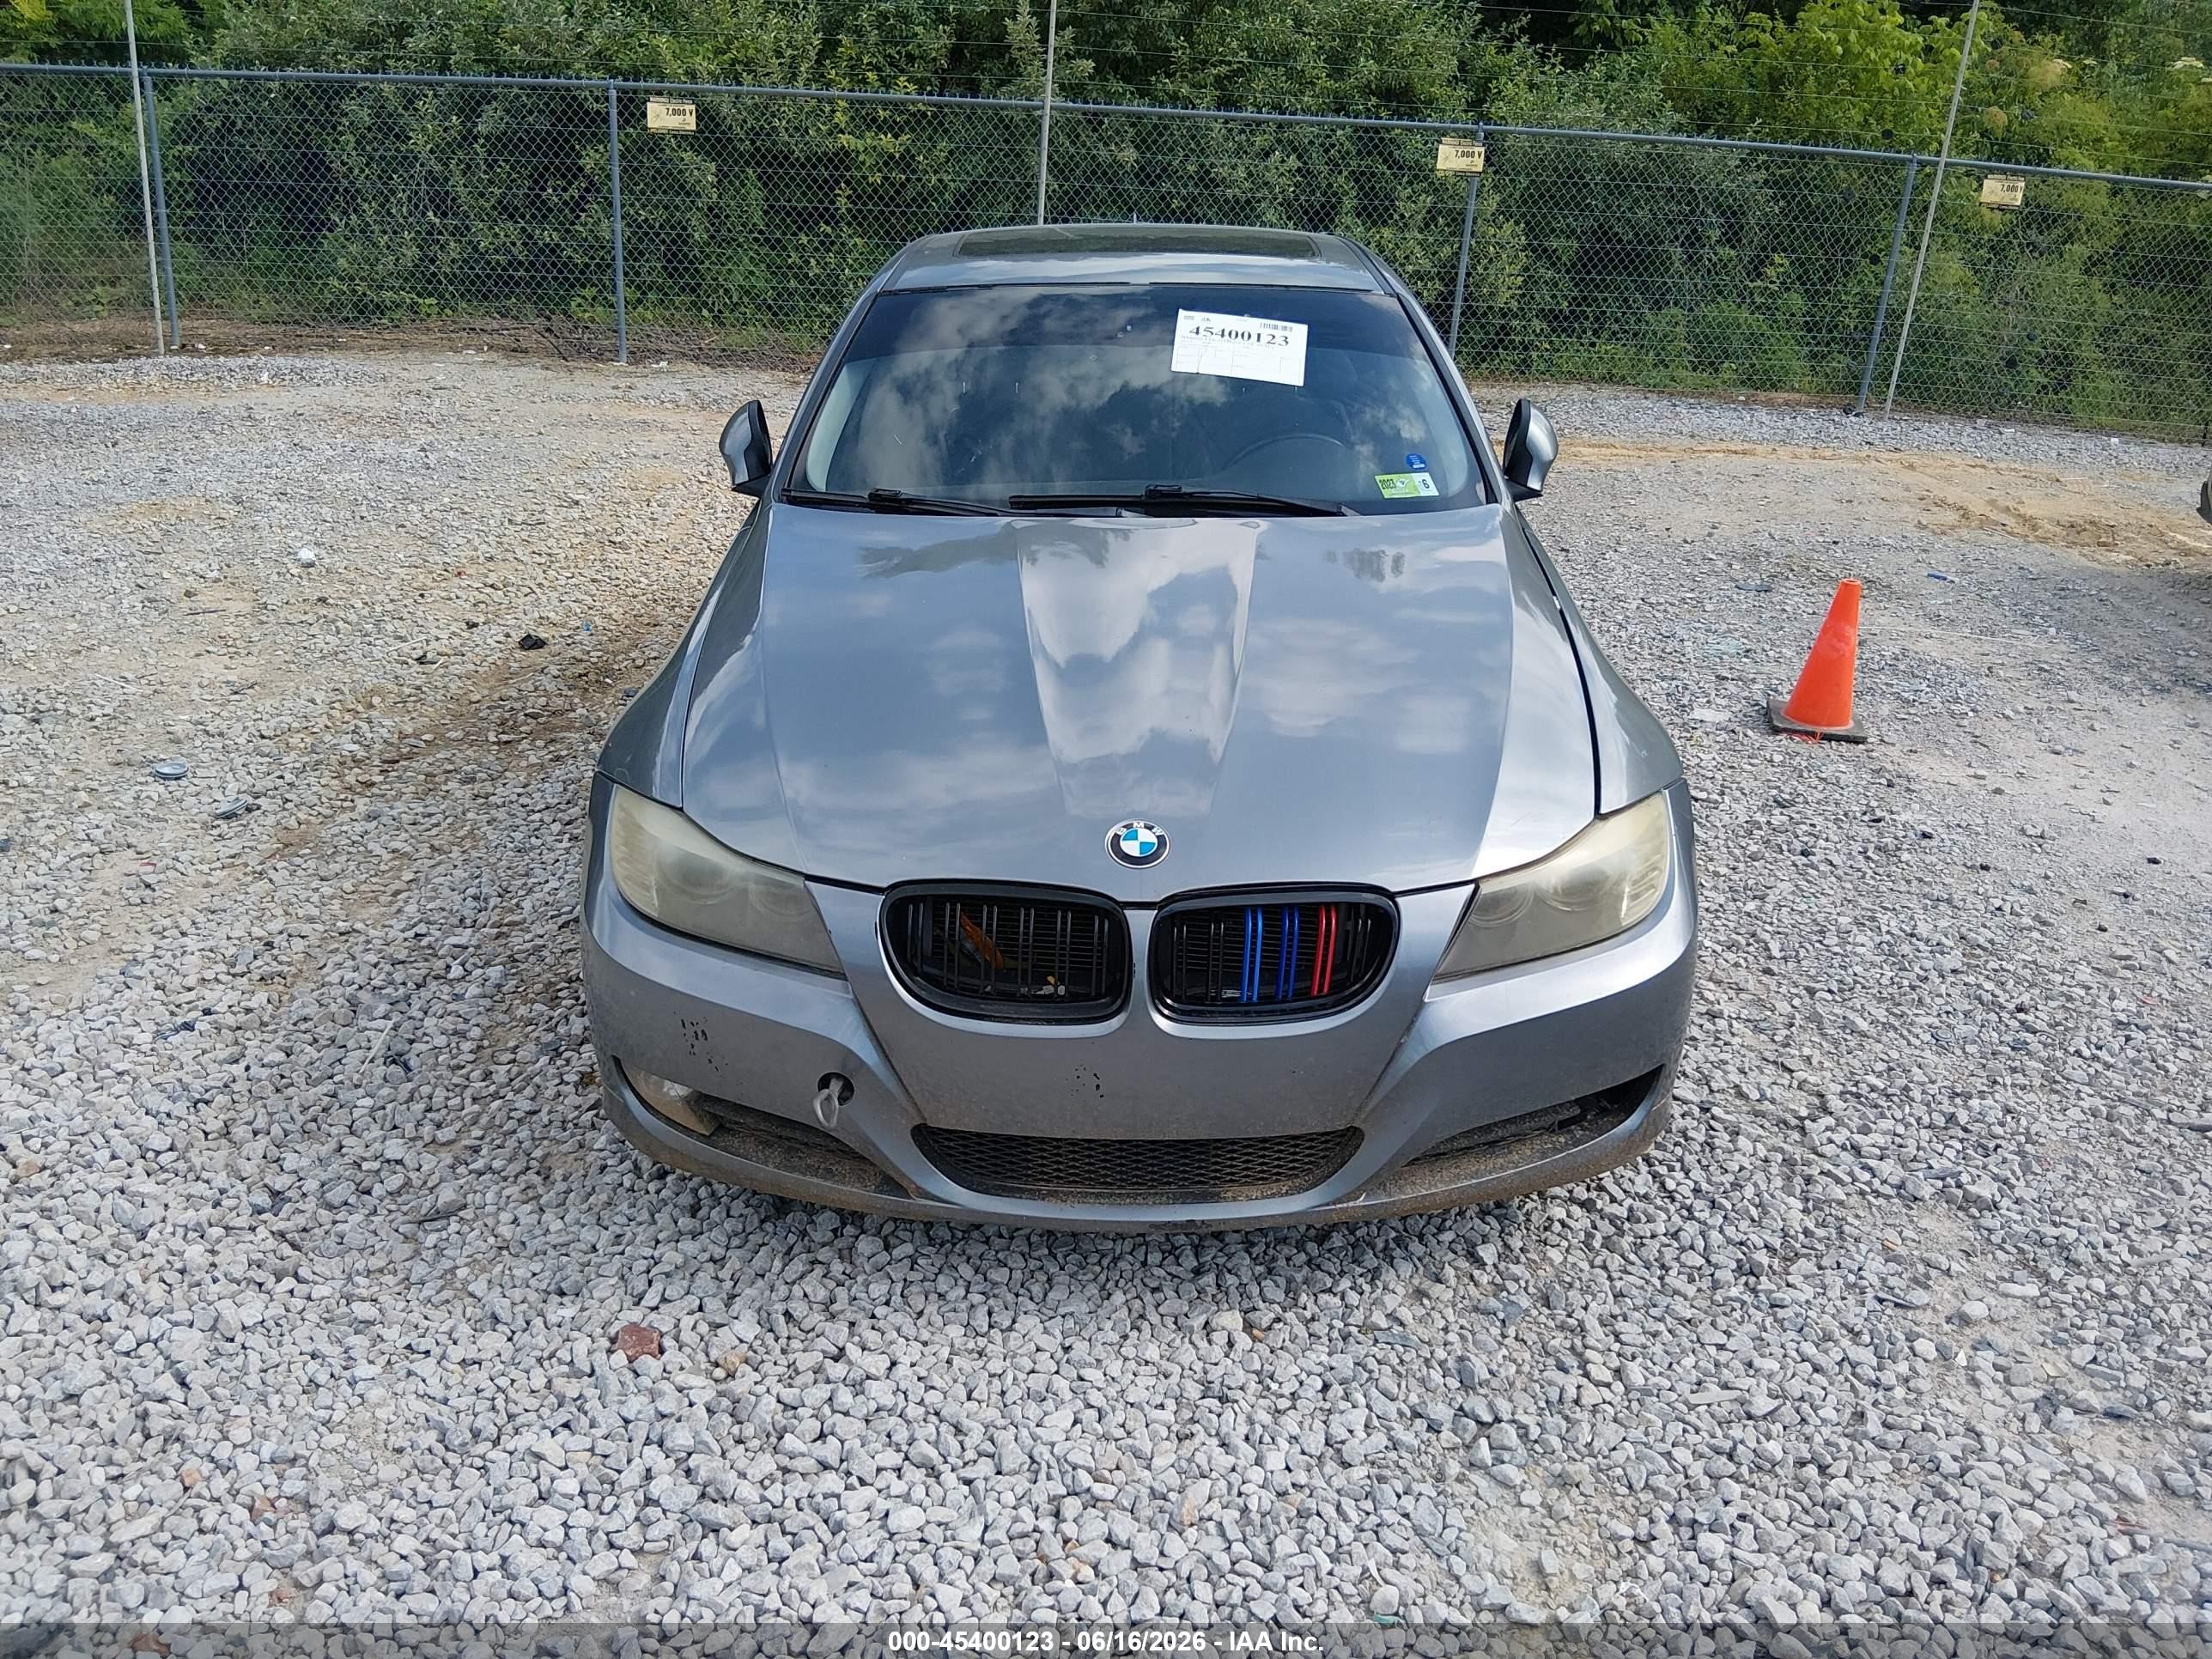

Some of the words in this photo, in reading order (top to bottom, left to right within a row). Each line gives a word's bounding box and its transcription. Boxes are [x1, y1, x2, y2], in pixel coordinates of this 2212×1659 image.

[665, 107, 687, 117] 7,000
[688, 108, 694, 117] V
[1455, 149, 1475, 159] 7,000
[1477, 150, 1483, 159] V
[2000, 184, 2019, 193] 7,000
[1189, 325, 1289, 347] 45400123
[1378, 478, 1396, 489] 2023
[1422, 478, 1430, 489] 6
[1115, 822, 1164, 836] BMW
